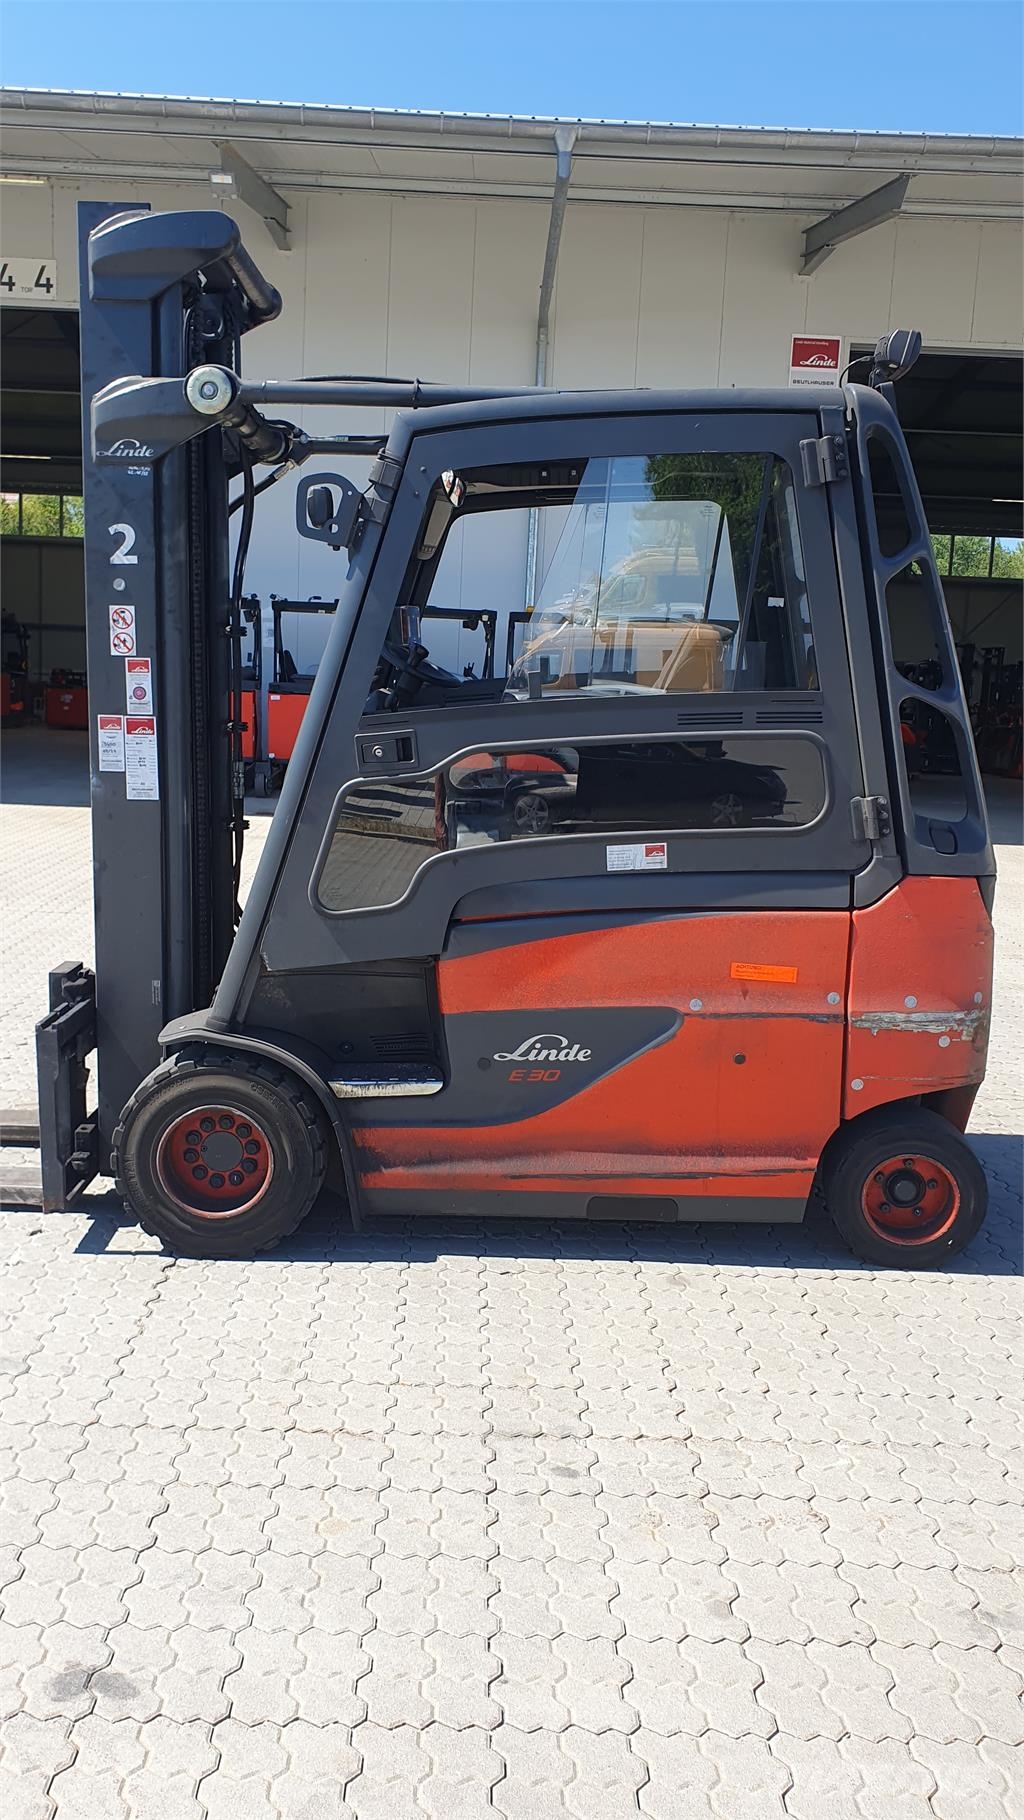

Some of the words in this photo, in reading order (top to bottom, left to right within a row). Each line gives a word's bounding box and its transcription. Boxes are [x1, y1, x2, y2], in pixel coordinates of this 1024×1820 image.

[0, 263, 16, 292] 4
[34, 265, 54, 294] 4
[800, 353, 836, 367] Linde
[96, 438, 154, 457] Linde
[108, 523, 138, 565] 2
[493, 1034, 592, 1062] Linde
